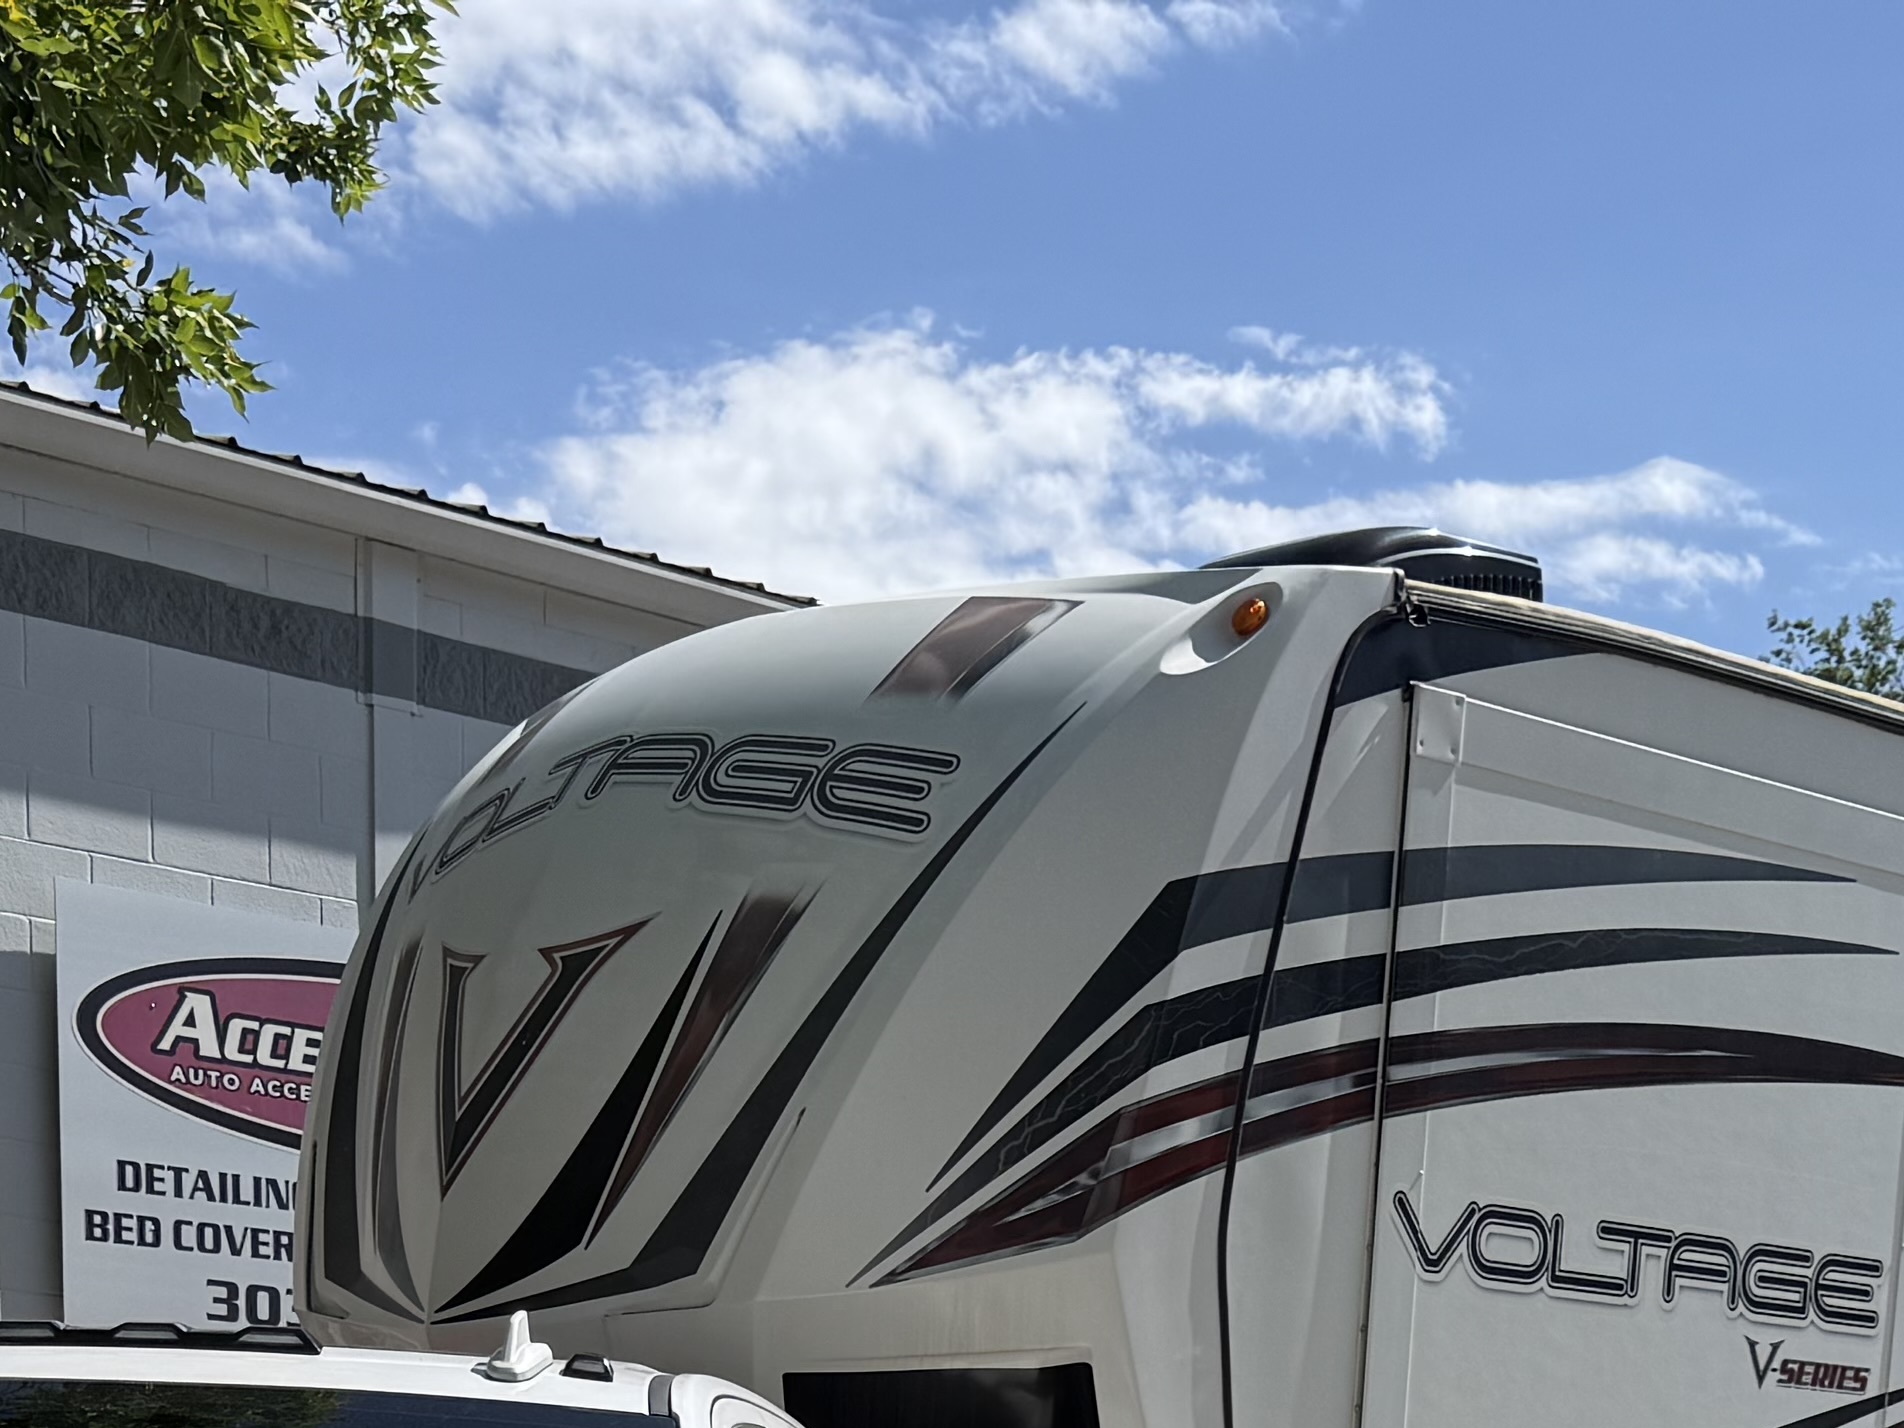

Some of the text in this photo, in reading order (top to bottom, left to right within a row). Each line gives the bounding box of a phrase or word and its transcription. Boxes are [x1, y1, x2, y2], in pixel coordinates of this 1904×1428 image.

[407, 733, 960, 903] VOLTAGE
[169, 1064, 241, 1091] AUTO
[117, 1159, 298, 1212] DETAILIN
[84, 1208, 162, 1248] BED
[1394, 1190, 1884, 1329] VOLTAGE
